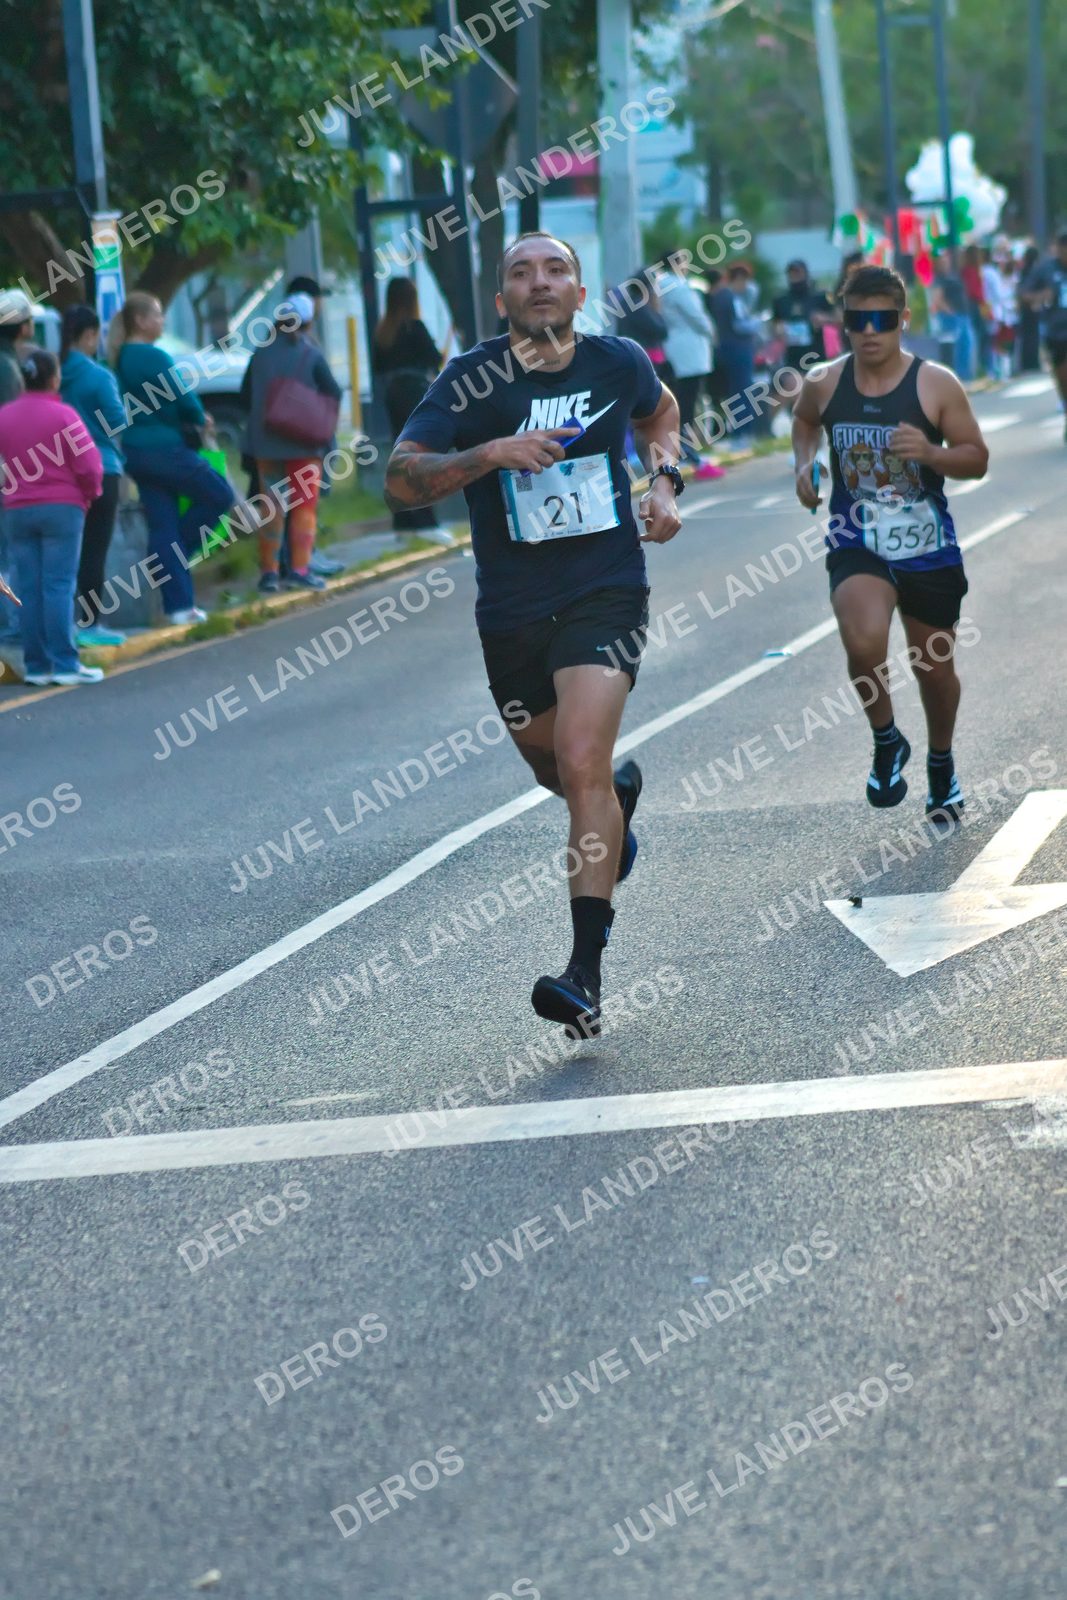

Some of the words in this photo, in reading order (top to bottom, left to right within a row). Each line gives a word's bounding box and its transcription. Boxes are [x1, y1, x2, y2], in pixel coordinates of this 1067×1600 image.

[526, 391, 592, 430] NIKE
[544, 492, 583, 528] 21
[870, 523, 936, 552] 1552
